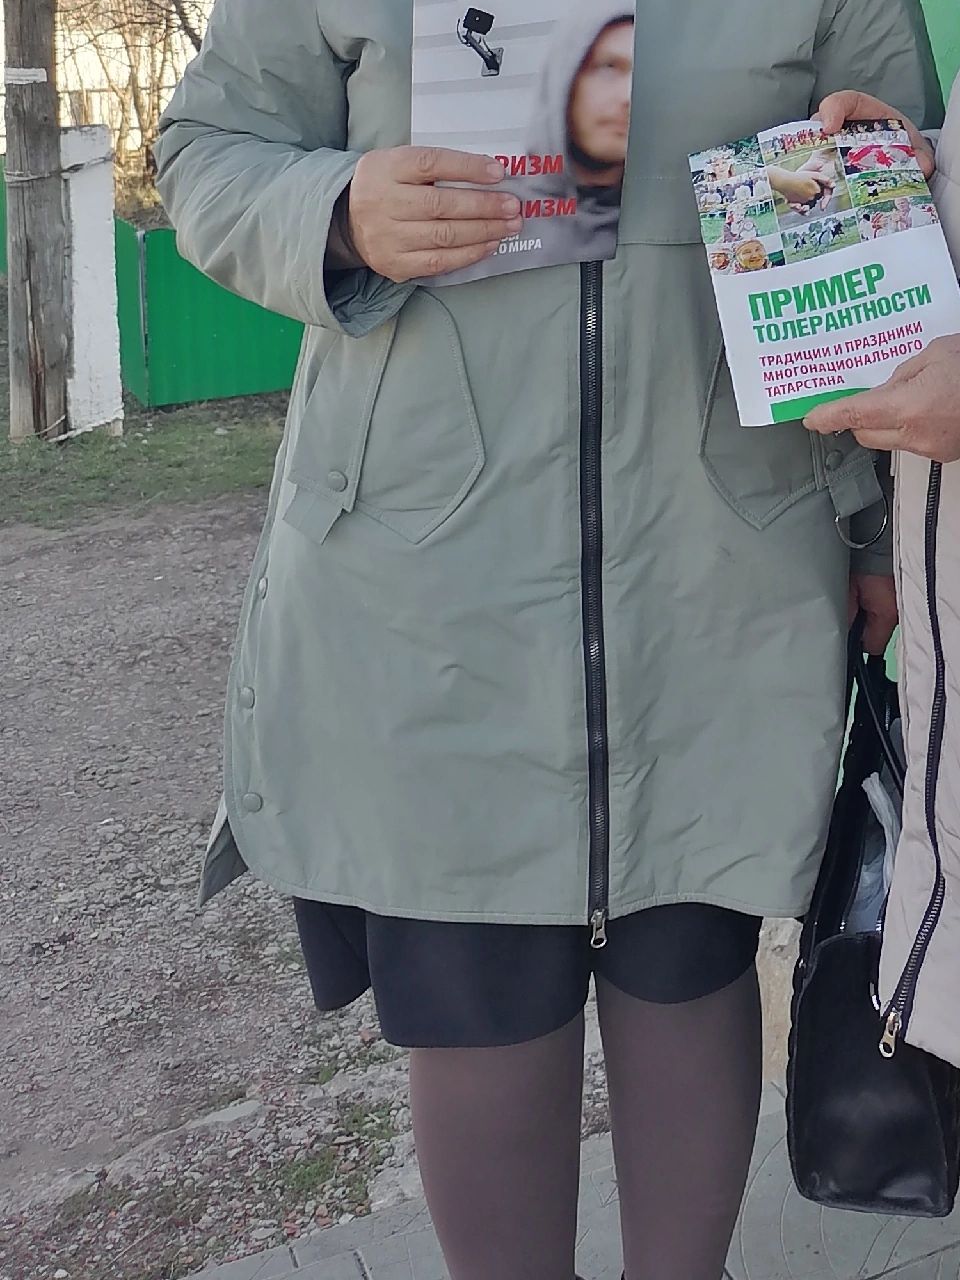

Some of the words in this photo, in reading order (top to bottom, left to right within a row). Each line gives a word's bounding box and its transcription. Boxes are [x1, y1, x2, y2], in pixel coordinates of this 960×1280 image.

[520, 197, 577, 219] ИЗМ
[508, 238, 543, 254] МИРА
[748, 262, 886, 321] ПРИМЕР
[753, 284, 933, 344] ТОЛЕРАНТНОСТИ
[759, 346, 831, 368] ТРАДИЦИИ
[833, 343, 844, 355] И
[844, 320, 923, 353] ПРАЗДНИКИ
[763, 339, 924, 383] МНОГОНАЦИОНАЛЬНОГО
[765, 374, 845, 398] ТАТАРСТАНА
